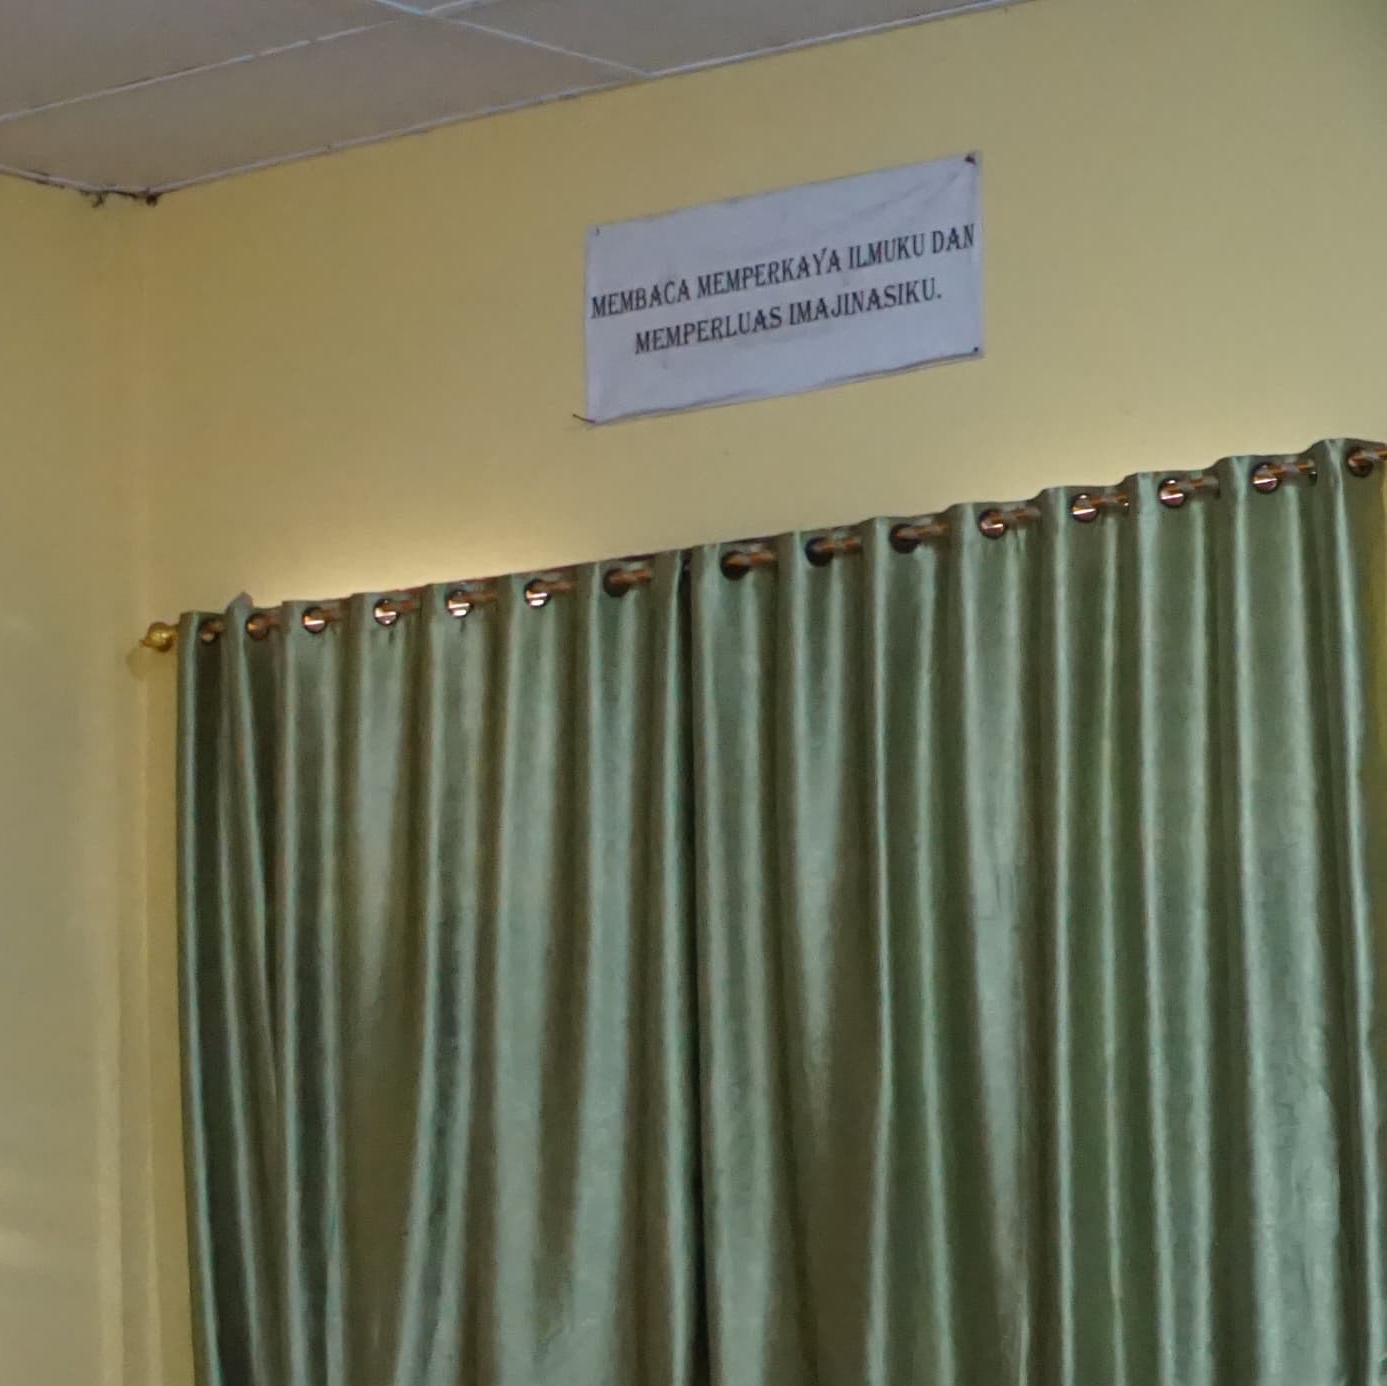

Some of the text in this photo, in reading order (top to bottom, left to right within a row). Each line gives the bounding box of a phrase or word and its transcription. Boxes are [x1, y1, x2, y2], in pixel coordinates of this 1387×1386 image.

[591, 223, 976, 319] MEMBACA MEMPERKAYA ILMUKU DAN
[634, 278, 943, 355] MEMPERLUAS IMAJINASIKU.
